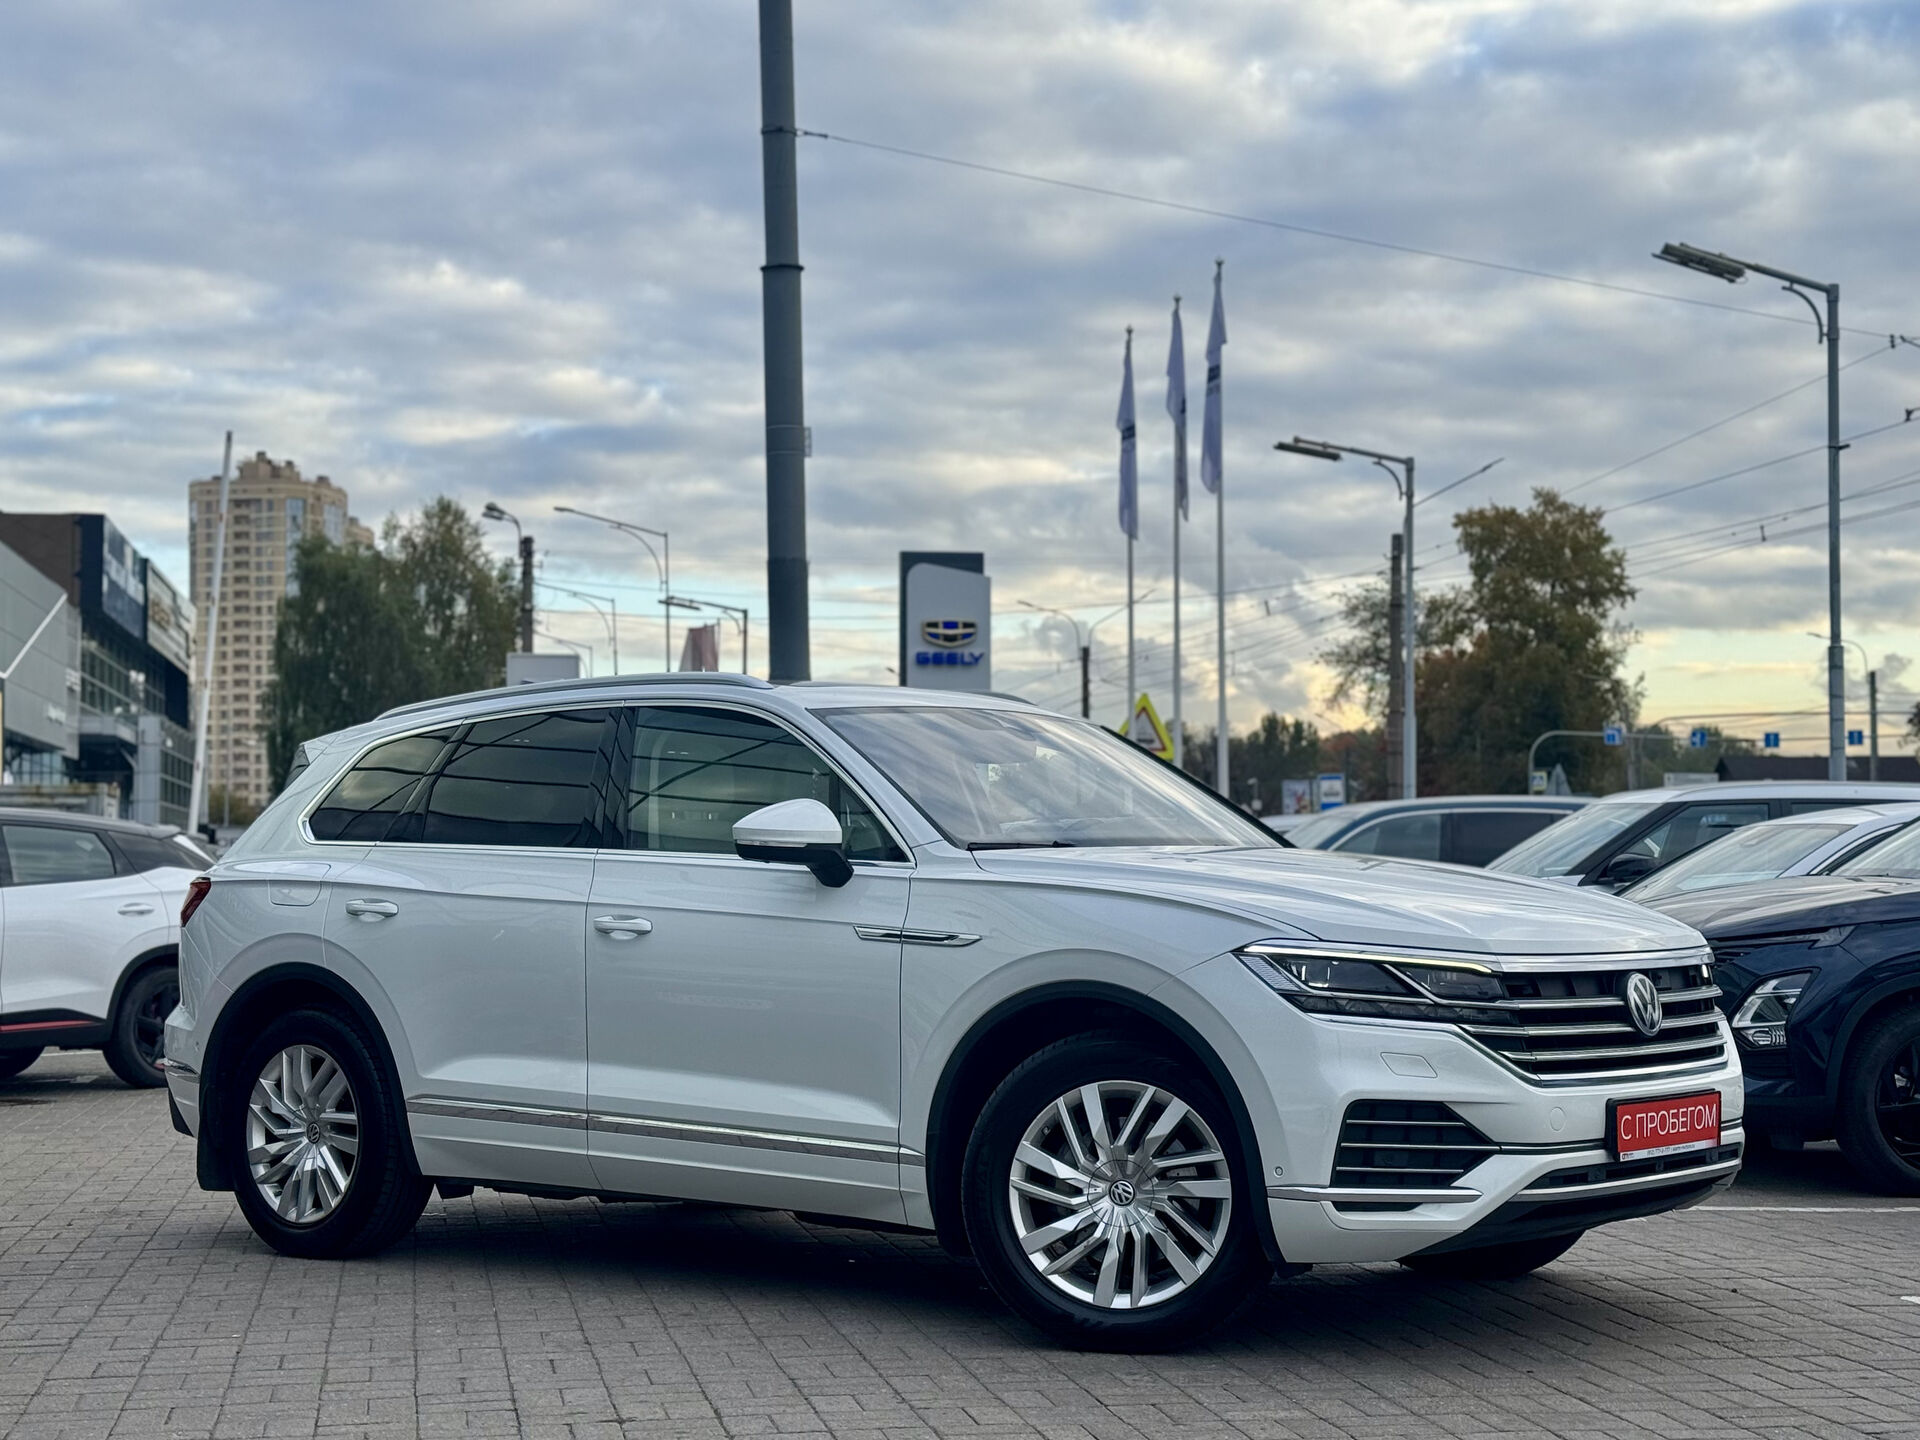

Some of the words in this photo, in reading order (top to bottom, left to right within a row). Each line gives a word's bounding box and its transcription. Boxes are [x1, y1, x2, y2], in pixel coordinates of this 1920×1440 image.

[915, 651, 984, 666] GEELY
[1621, 1115, 1632, 1140] С
[1636, 1103, 1717, 1139] ПРОБЕГОМ
